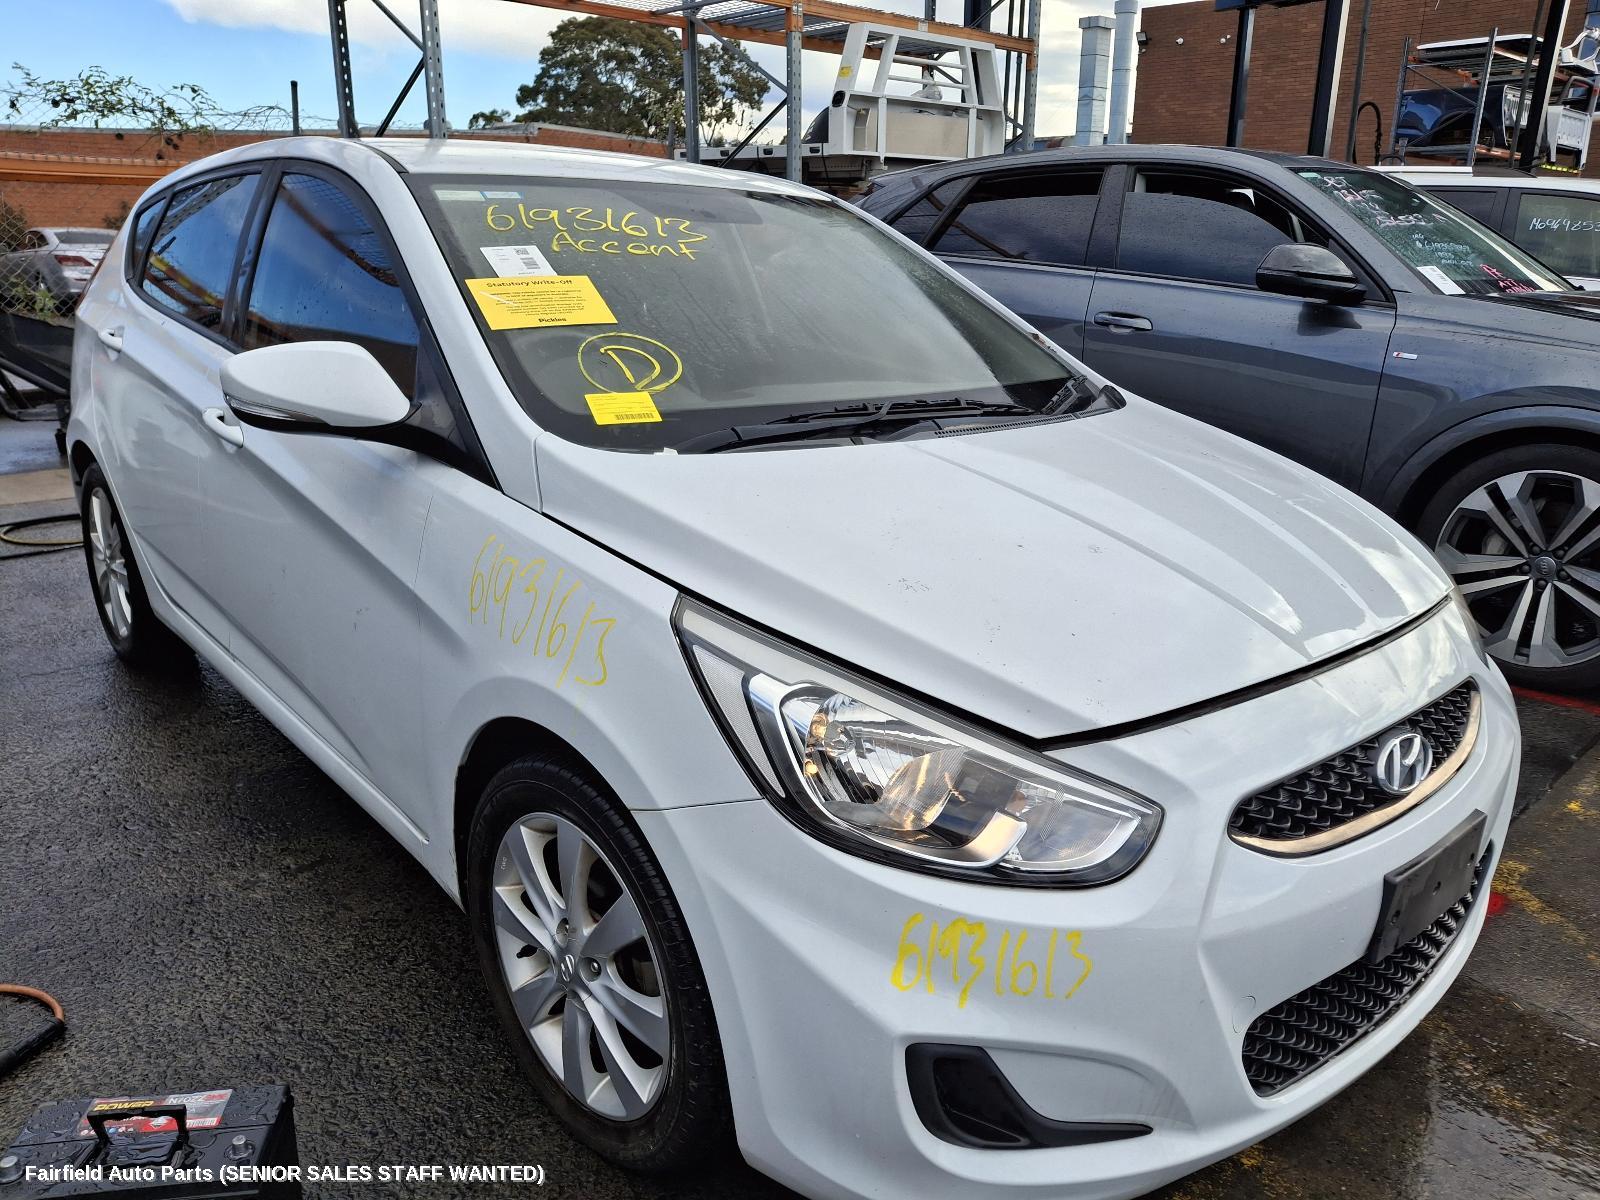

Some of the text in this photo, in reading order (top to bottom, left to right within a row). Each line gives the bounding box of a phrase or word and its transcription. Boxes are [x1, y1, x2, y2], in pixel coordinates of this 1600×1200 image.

[486, 203, 708, 242] 61931613
[486, 280, 530, 288] Statutory
[469, 534, 617, 689] 61931613
[890, 912, 1093, 1009] 61931613
